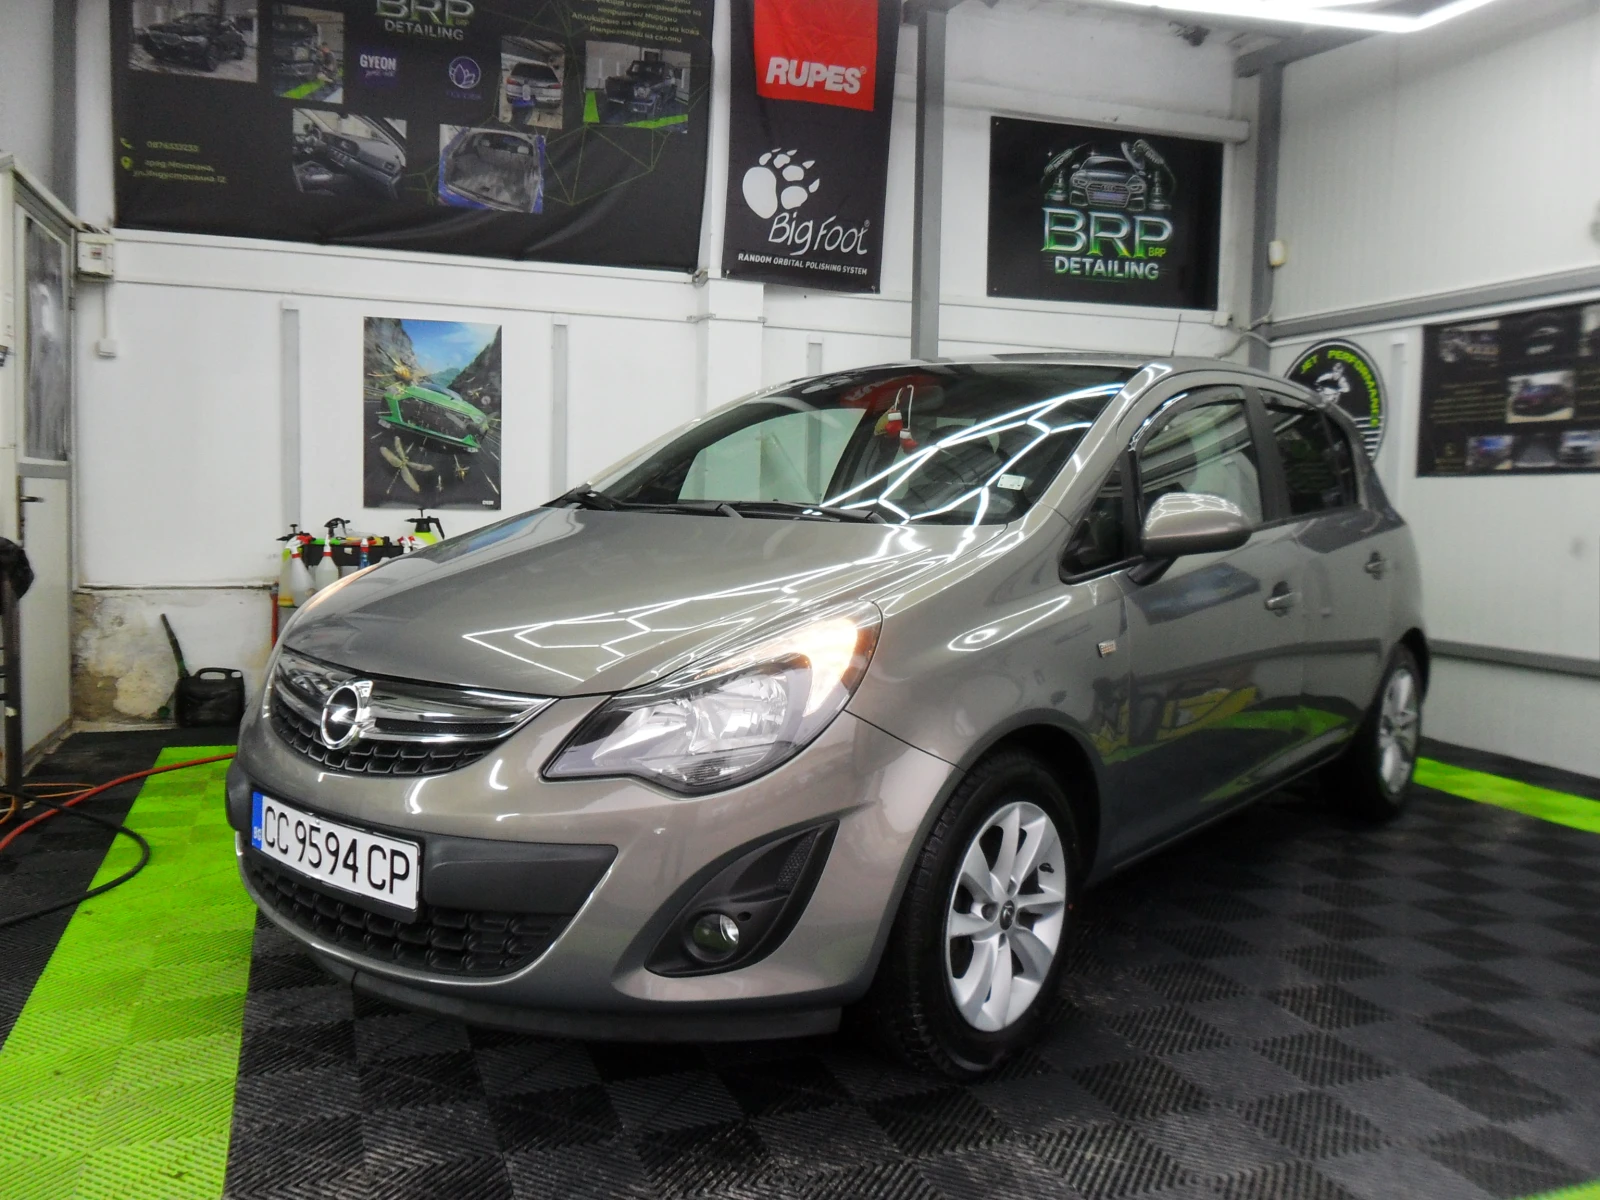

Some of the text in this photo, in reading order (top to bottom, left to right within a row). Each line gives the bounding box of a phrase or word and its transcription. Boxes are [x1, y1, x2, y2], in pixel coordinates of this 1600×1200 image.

[384, 19, 464, 41] DETAILING
[360, 54, 397, 71] GYEON
[766, 56, 862, 94] RUPES
[1041, 207, 1173, 258] BRP
[1148, 247, 1167, 257] BRP
[738, 253, 868, 276] RANDOM ORBITAL POLISHING SYSTEM
[1055, 256, 1159, 281] DETAILING
[264, 806, 410, 894] CC 9594 CP
